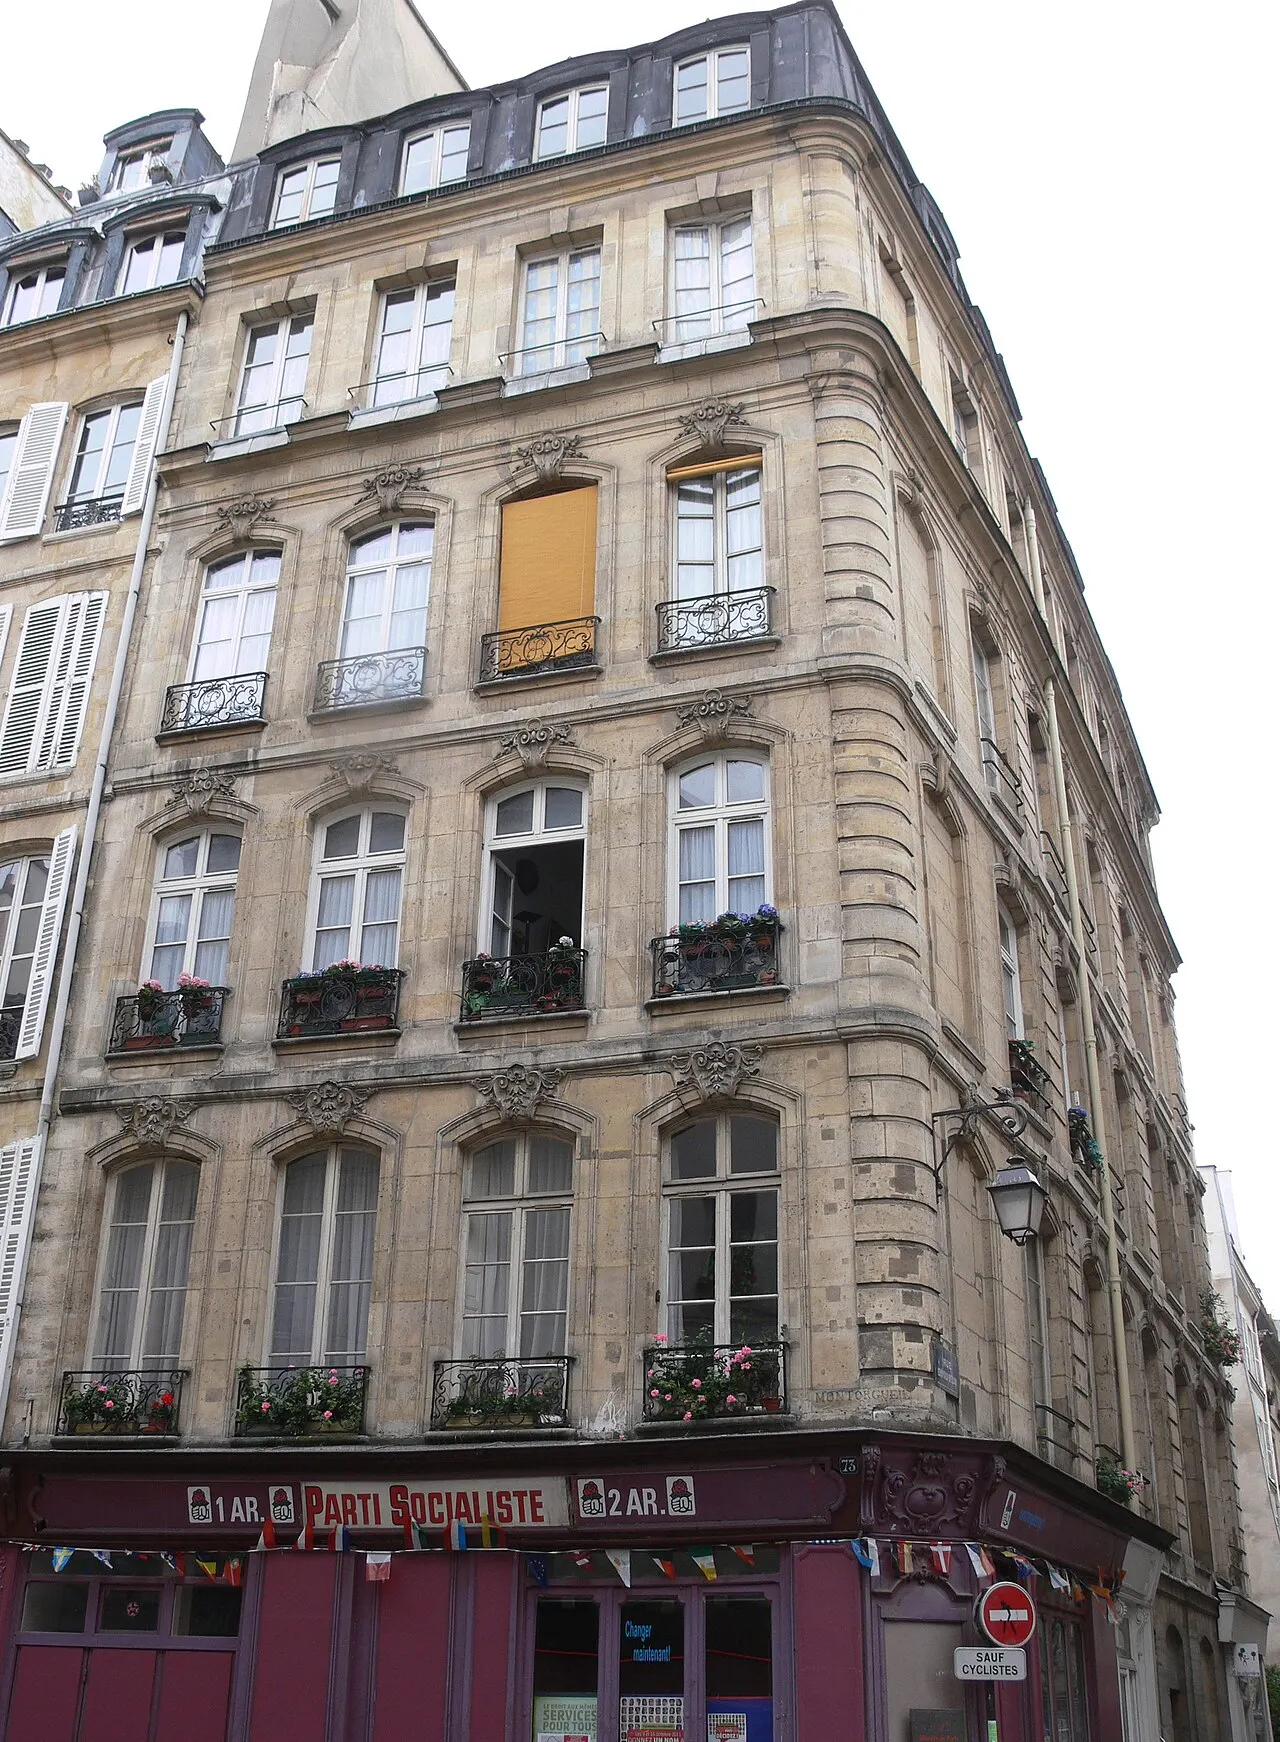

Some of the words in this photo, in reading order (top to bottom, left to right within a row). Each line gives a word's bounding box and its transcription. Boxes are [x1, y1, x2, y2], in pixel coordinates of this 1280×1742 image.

[815, 1389, 912, 1403] MONTORGUEIL
[841, 1458, 856, 1472] 73
[215, 1496, 225, 1522] 1
[230, 1496, 265, 1522] AR.
[304, 1485, 382, 1526] PARTI
[389, 1484, 545, 1526] SOCIALISTE
[608, 1488, 622, 1516] 2
[626, 1488, 666, 1516] AR.
[624, 1620, 652, 1642] Changer
[633, 1644, 671, 1662] maintenant!
[976, 1652, 1004, 1662] SAUF
[962, 1664, 1018, 1676] CYCLISTES
[543, 1710, 597, 1721] SERVICES
[542, 1721, 570, 1731] POUR
[571, 1721, 597, 1731] TOUS
